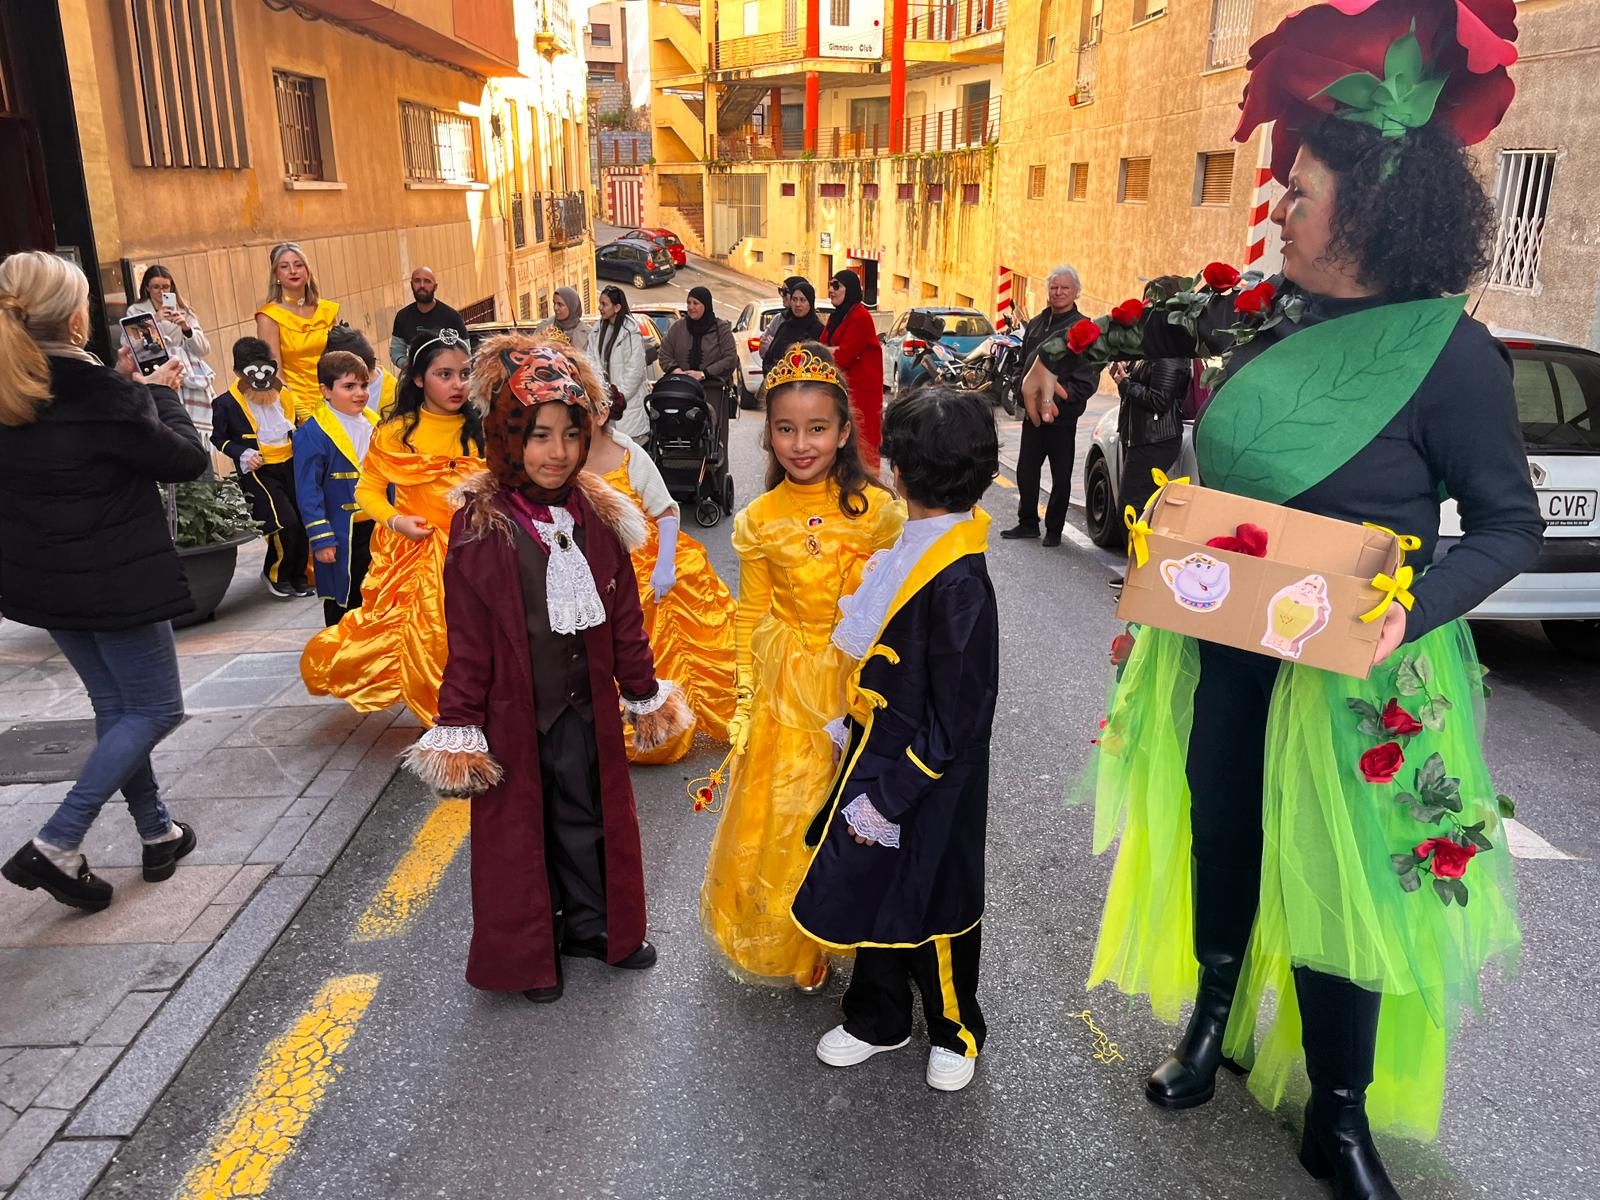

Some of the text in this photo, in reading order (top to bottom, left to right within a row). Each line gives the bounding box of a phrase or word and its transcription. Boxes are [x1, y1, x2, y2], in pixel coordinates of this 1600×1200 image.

[829, 43, 872, 52] Gimnasio Club
[1549, 496, 1587, 516] CVR
